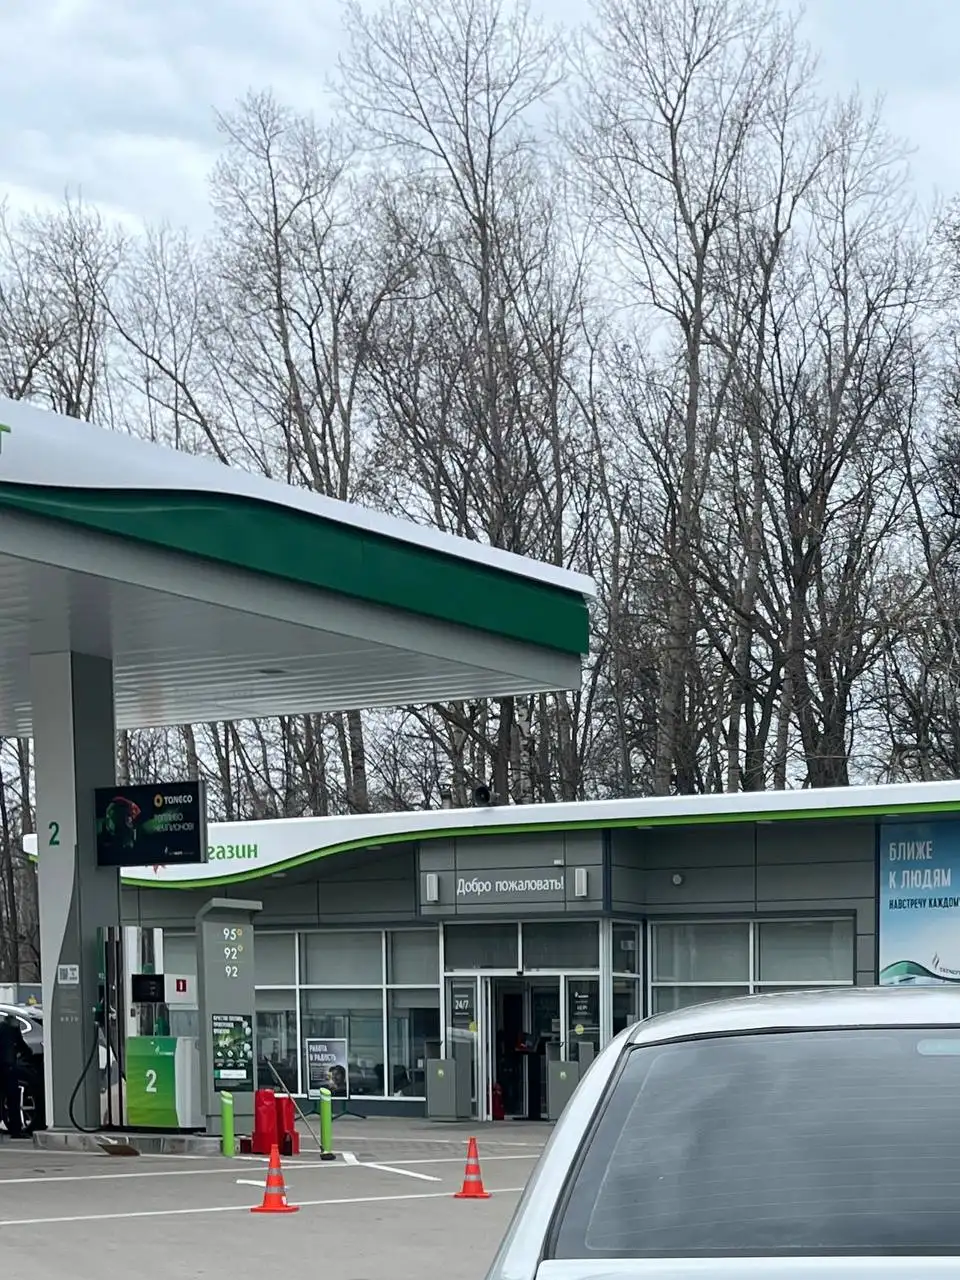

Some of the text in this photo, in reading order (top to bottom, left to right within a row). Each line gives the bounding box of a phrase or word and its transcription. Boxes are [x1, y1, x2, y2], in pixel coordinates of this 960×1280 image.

[49, 821, 60, 846] 2
[207, 843, 258, 860] газин
[889, 841, 933, 861] БЛИЖЕ
[457, 876, 564, 896] Добро пожаловать!
[889, 868, 951, 890] К ЛЮДЯМ
[889, 898, 927, 910] НАВСТРЕЧУ
[223, 928, 237, 941] 95
[224, 947, 238, 960] 92
[225, 966, 238, 978] 92
[145, 1069, 158, 1093] 2
